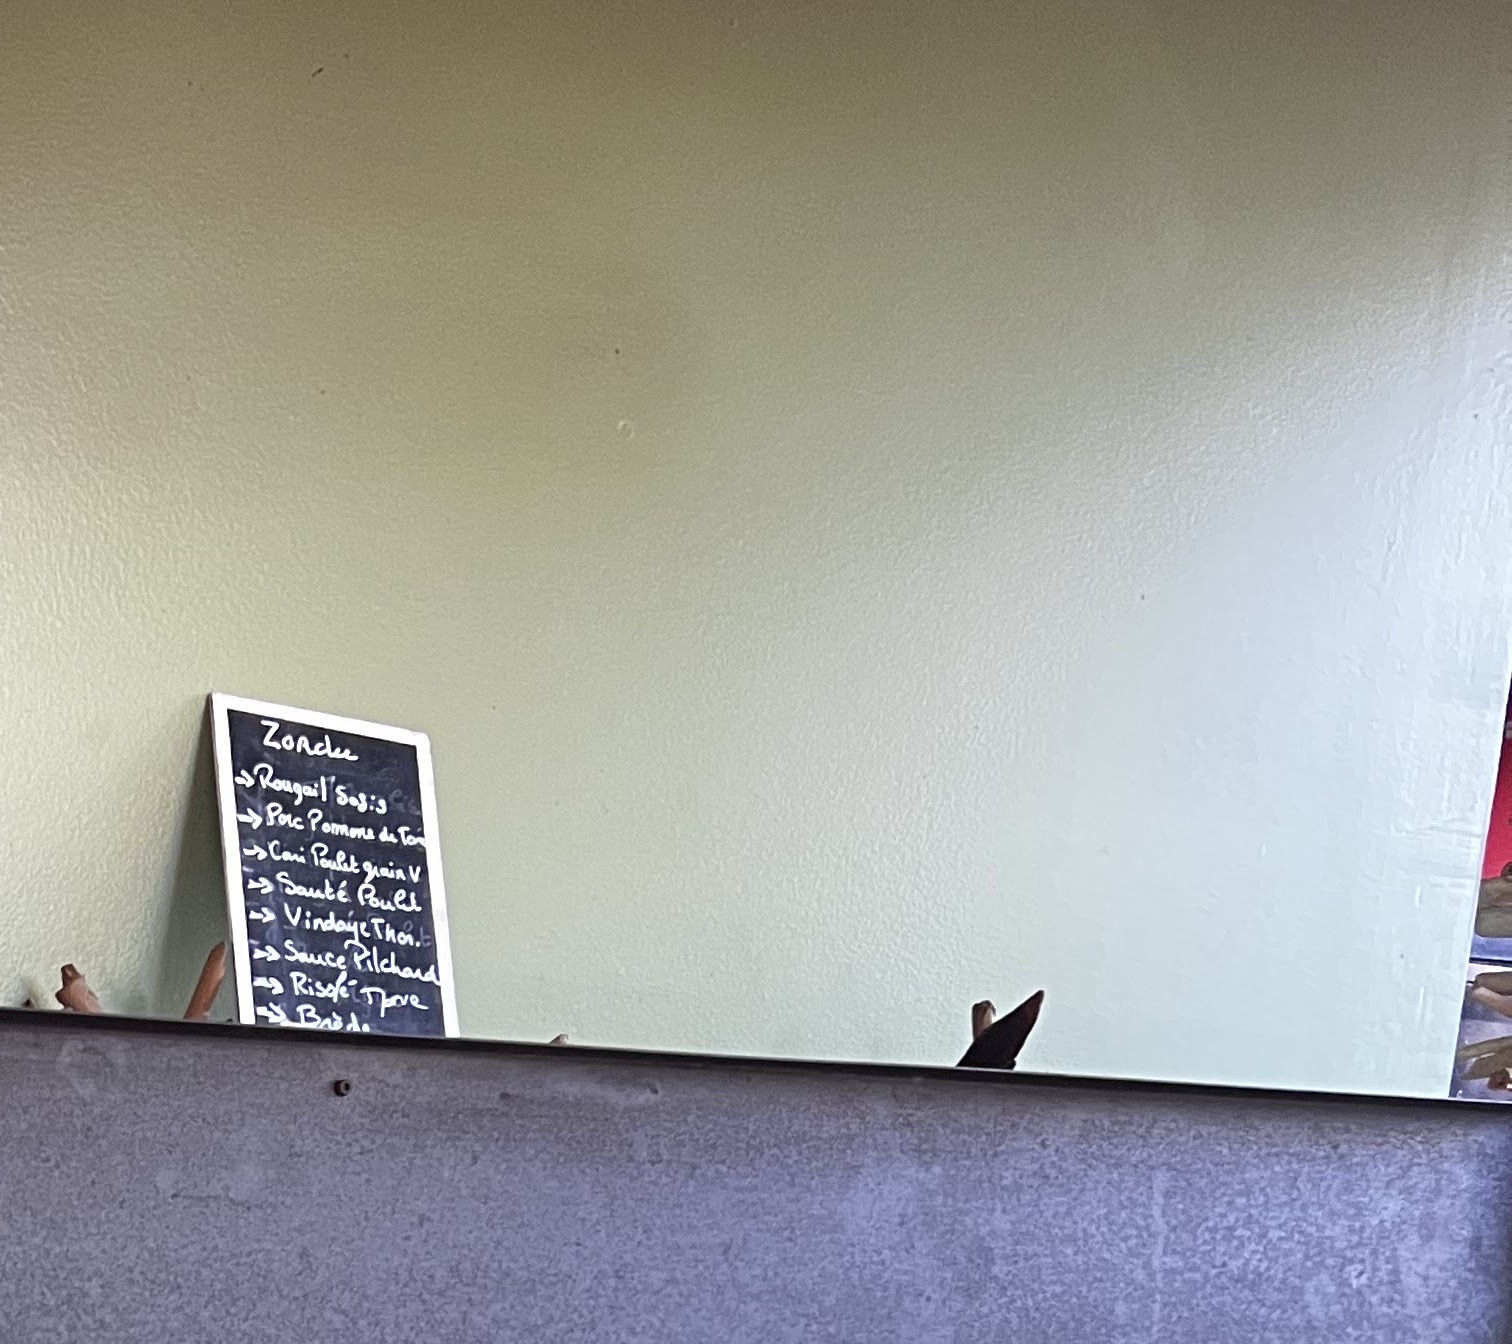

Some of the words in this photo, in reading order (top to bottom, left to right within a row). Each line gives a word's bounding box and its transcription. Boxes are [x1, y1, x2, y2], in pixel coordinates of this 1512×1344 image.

[253, 763, 328, 806] Rougail
[266, 802, 305, 830] Porc
[310, 842, 360, 874] Poulet
[284, 939, 348, 970] Sauce
